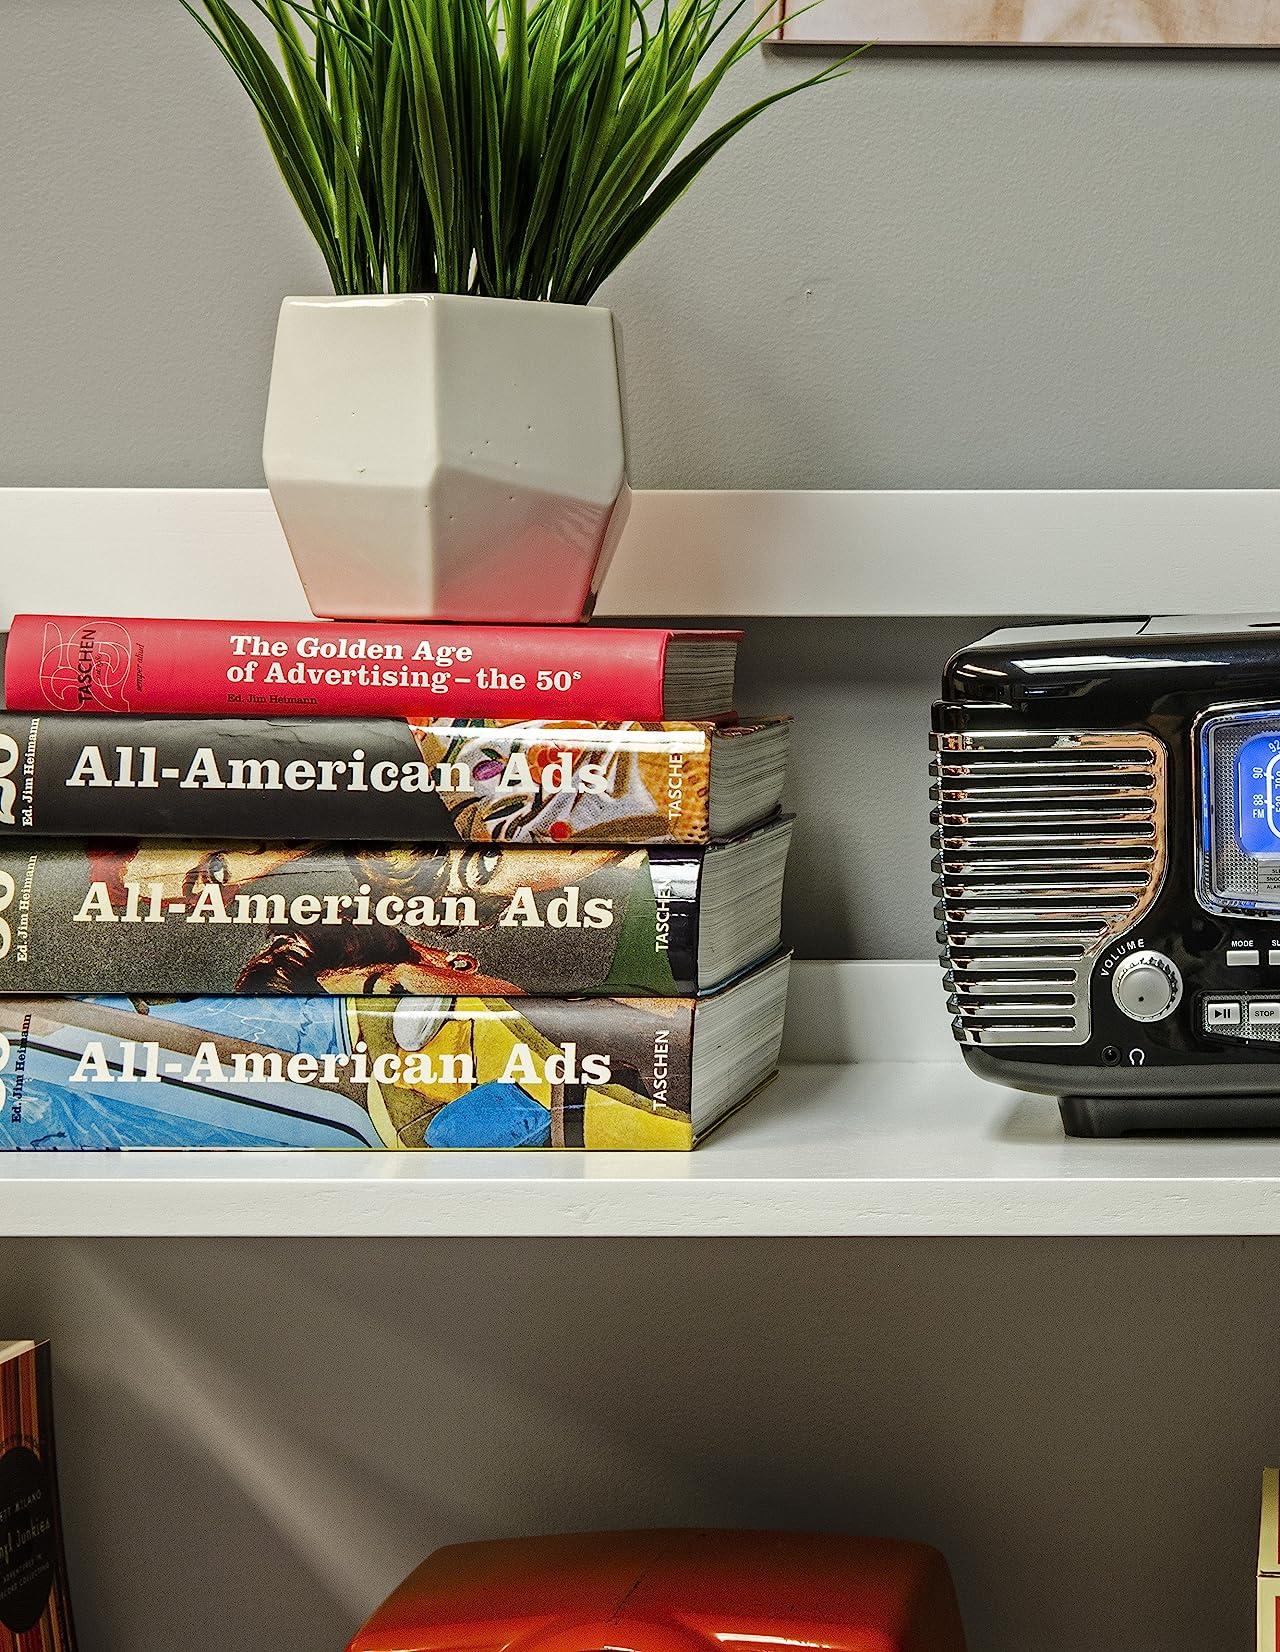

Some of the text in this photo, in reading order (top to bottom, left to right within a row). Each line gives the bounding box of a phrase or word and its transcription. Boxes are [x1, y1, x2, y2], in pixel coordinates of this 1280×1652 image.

[77, 629, 97, 704] TASCHEN
[226, 660, 259, 683] of
[229, 635, 473, 667] The Golden Age
[247, 693, 267, 704] Jim
[269, 694, 318, 705] Heimann
[21, 718, 40, 827] Ed. Jim Heimann
[65, 745, 475, 793] All-American
[495, 751, 609, 795] Ads
[667, 752, 684, 821] TASCHE
[1252, 767, 1264, 779] 90
[1252, 794, 1264, 806] 88
[1252, 808, 1265, 819] FM
[17, 854, 38, 962] Ed. Jim Heimann
[72, 880, 614, 930] All-American Ads
[1100, 938, 1146, 977] VOLUME
[1231, 940, 1254, 948] MODE
[11, 1014, 32, 1123] Ed. Jim Heimann
[68, 1041, 613, 1086] All-American Ads
[652, 1029, 670, 1111] TASCHEN
